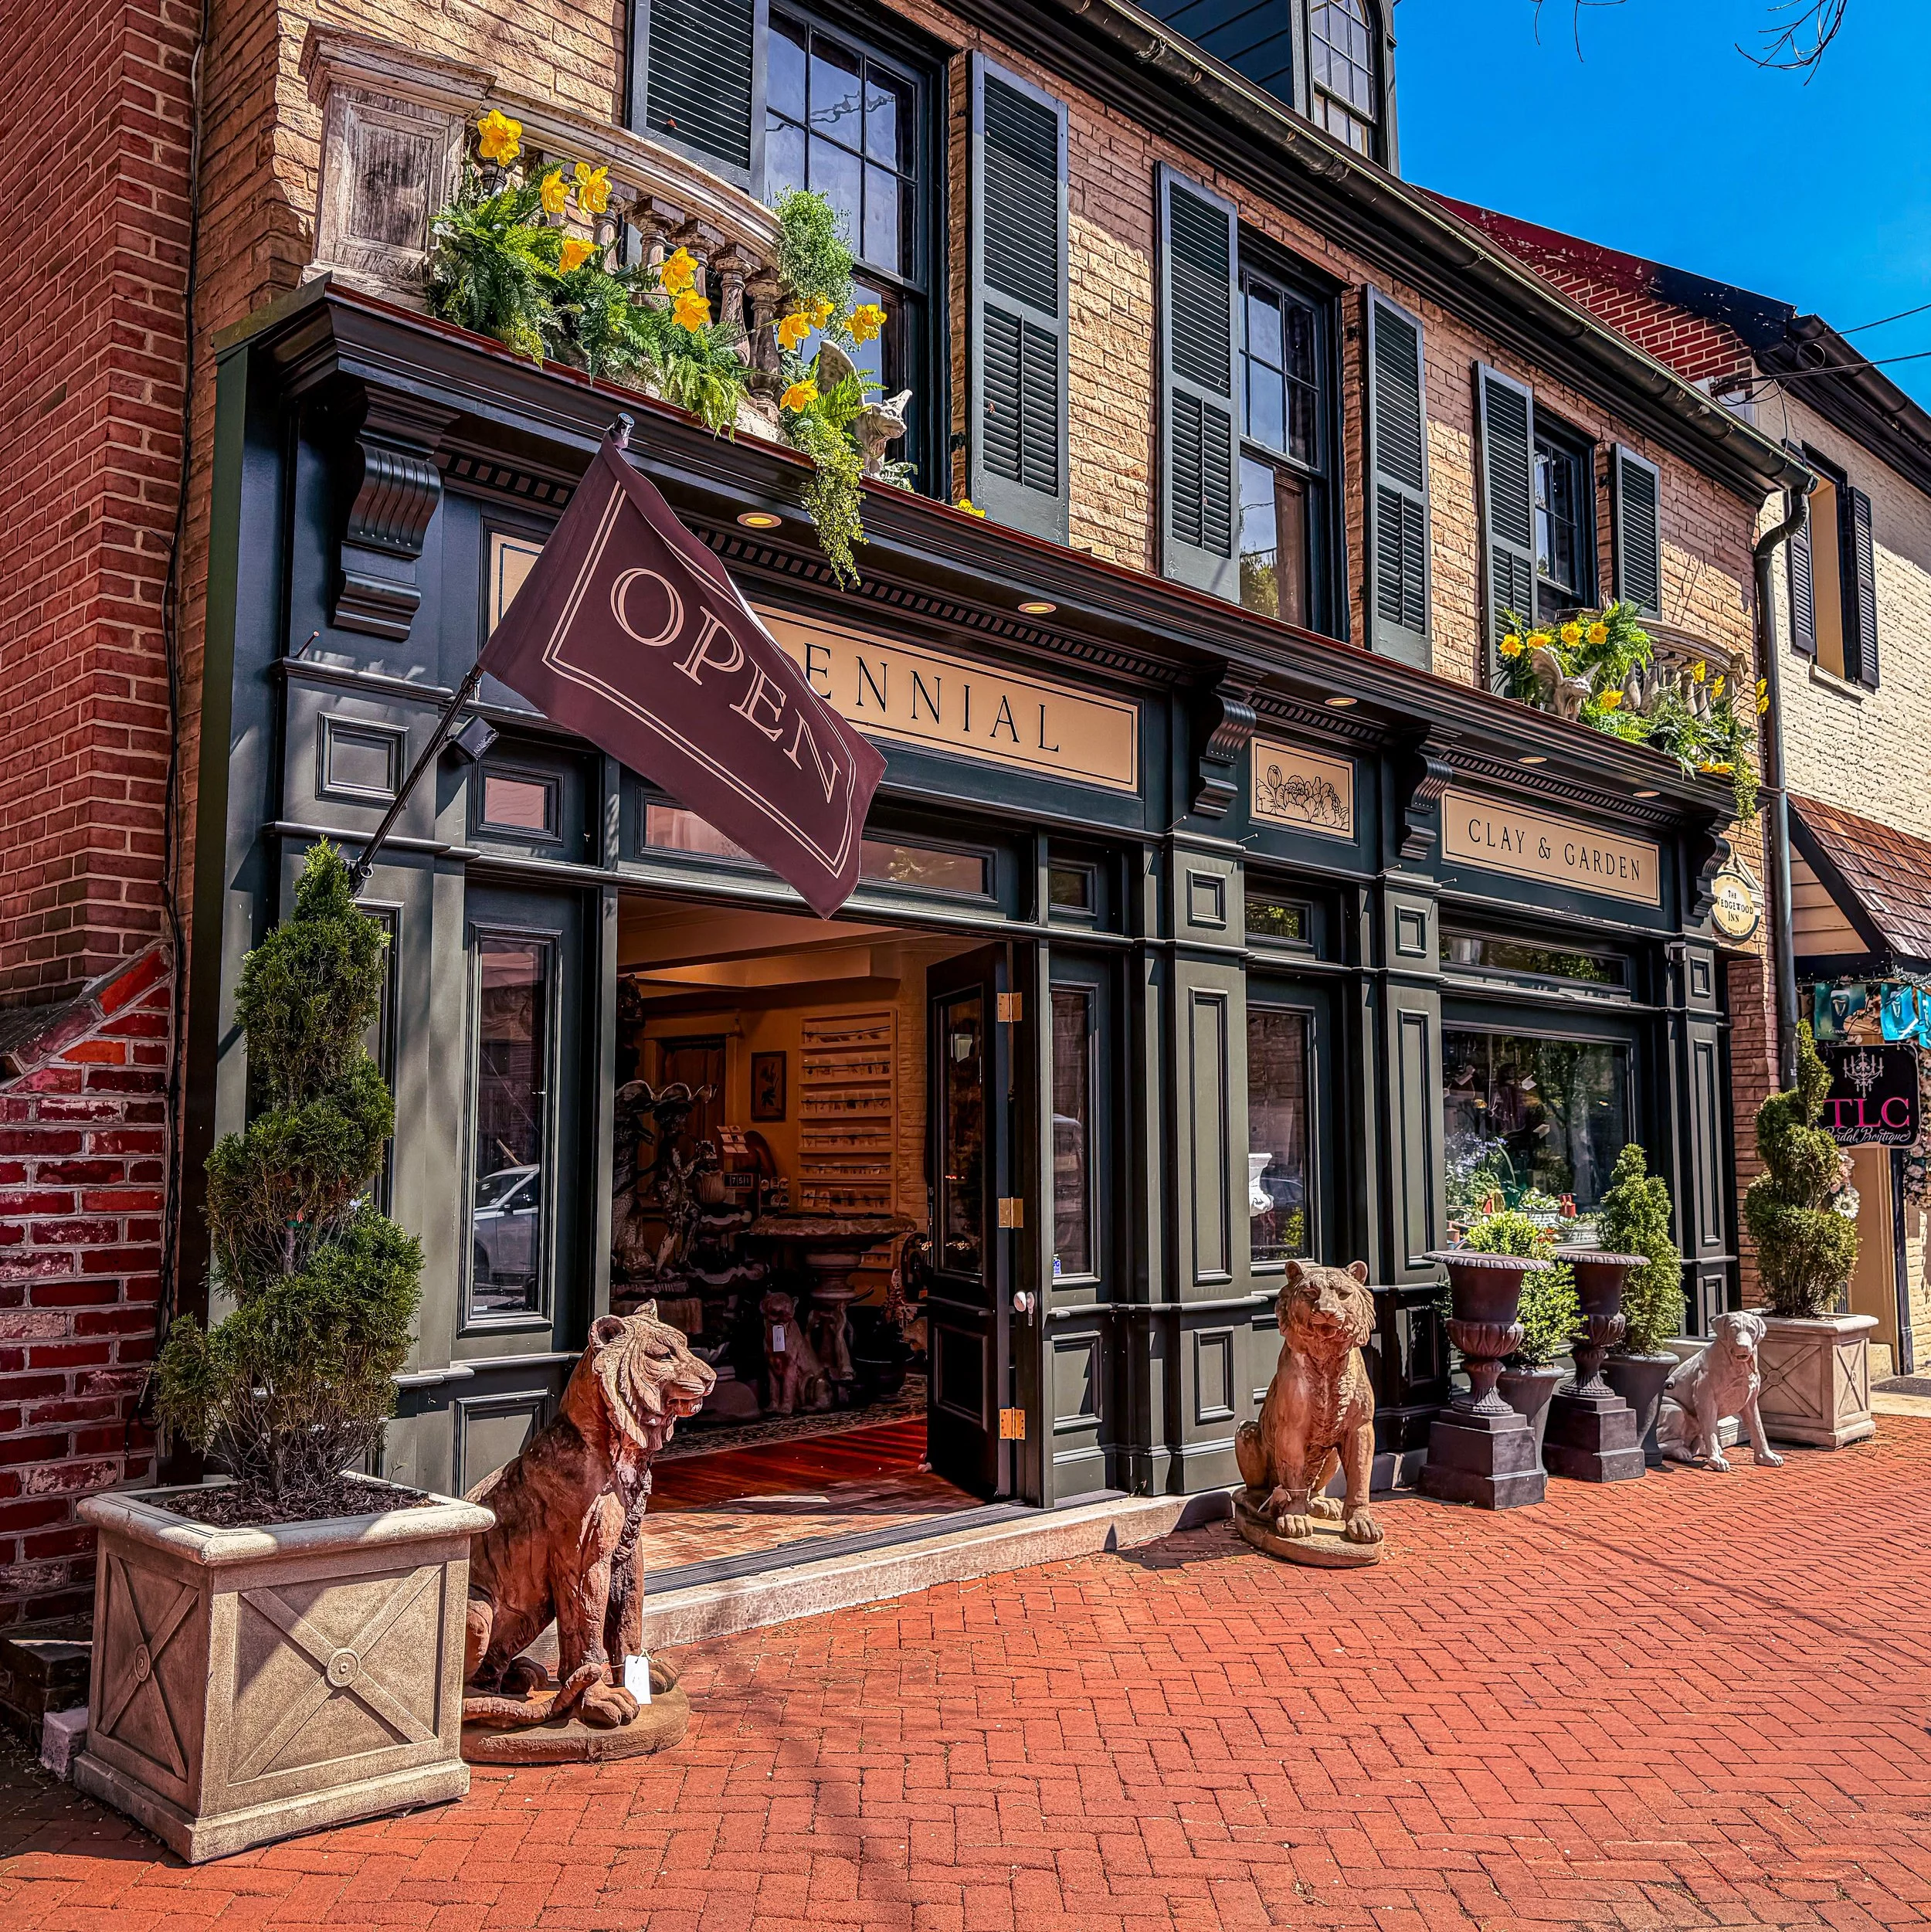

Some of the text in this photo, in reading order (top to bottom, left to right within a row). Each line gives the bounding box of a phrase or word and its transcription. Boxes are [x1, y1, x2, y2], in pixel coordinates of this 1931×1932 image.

[610, 568, 842, 804] OPEN
[803, 642, 1060, 753] ENNIAL
[1468, 819, 1640, 881] CLAY & GARDEN
[1728, 890, 1736, 899] THE
[1728, 912, 1739, 922] INN
[1823, 1097, 1910, 1128] TLC
[1824, 1126, 1912, 1144] Bridal Boutique
